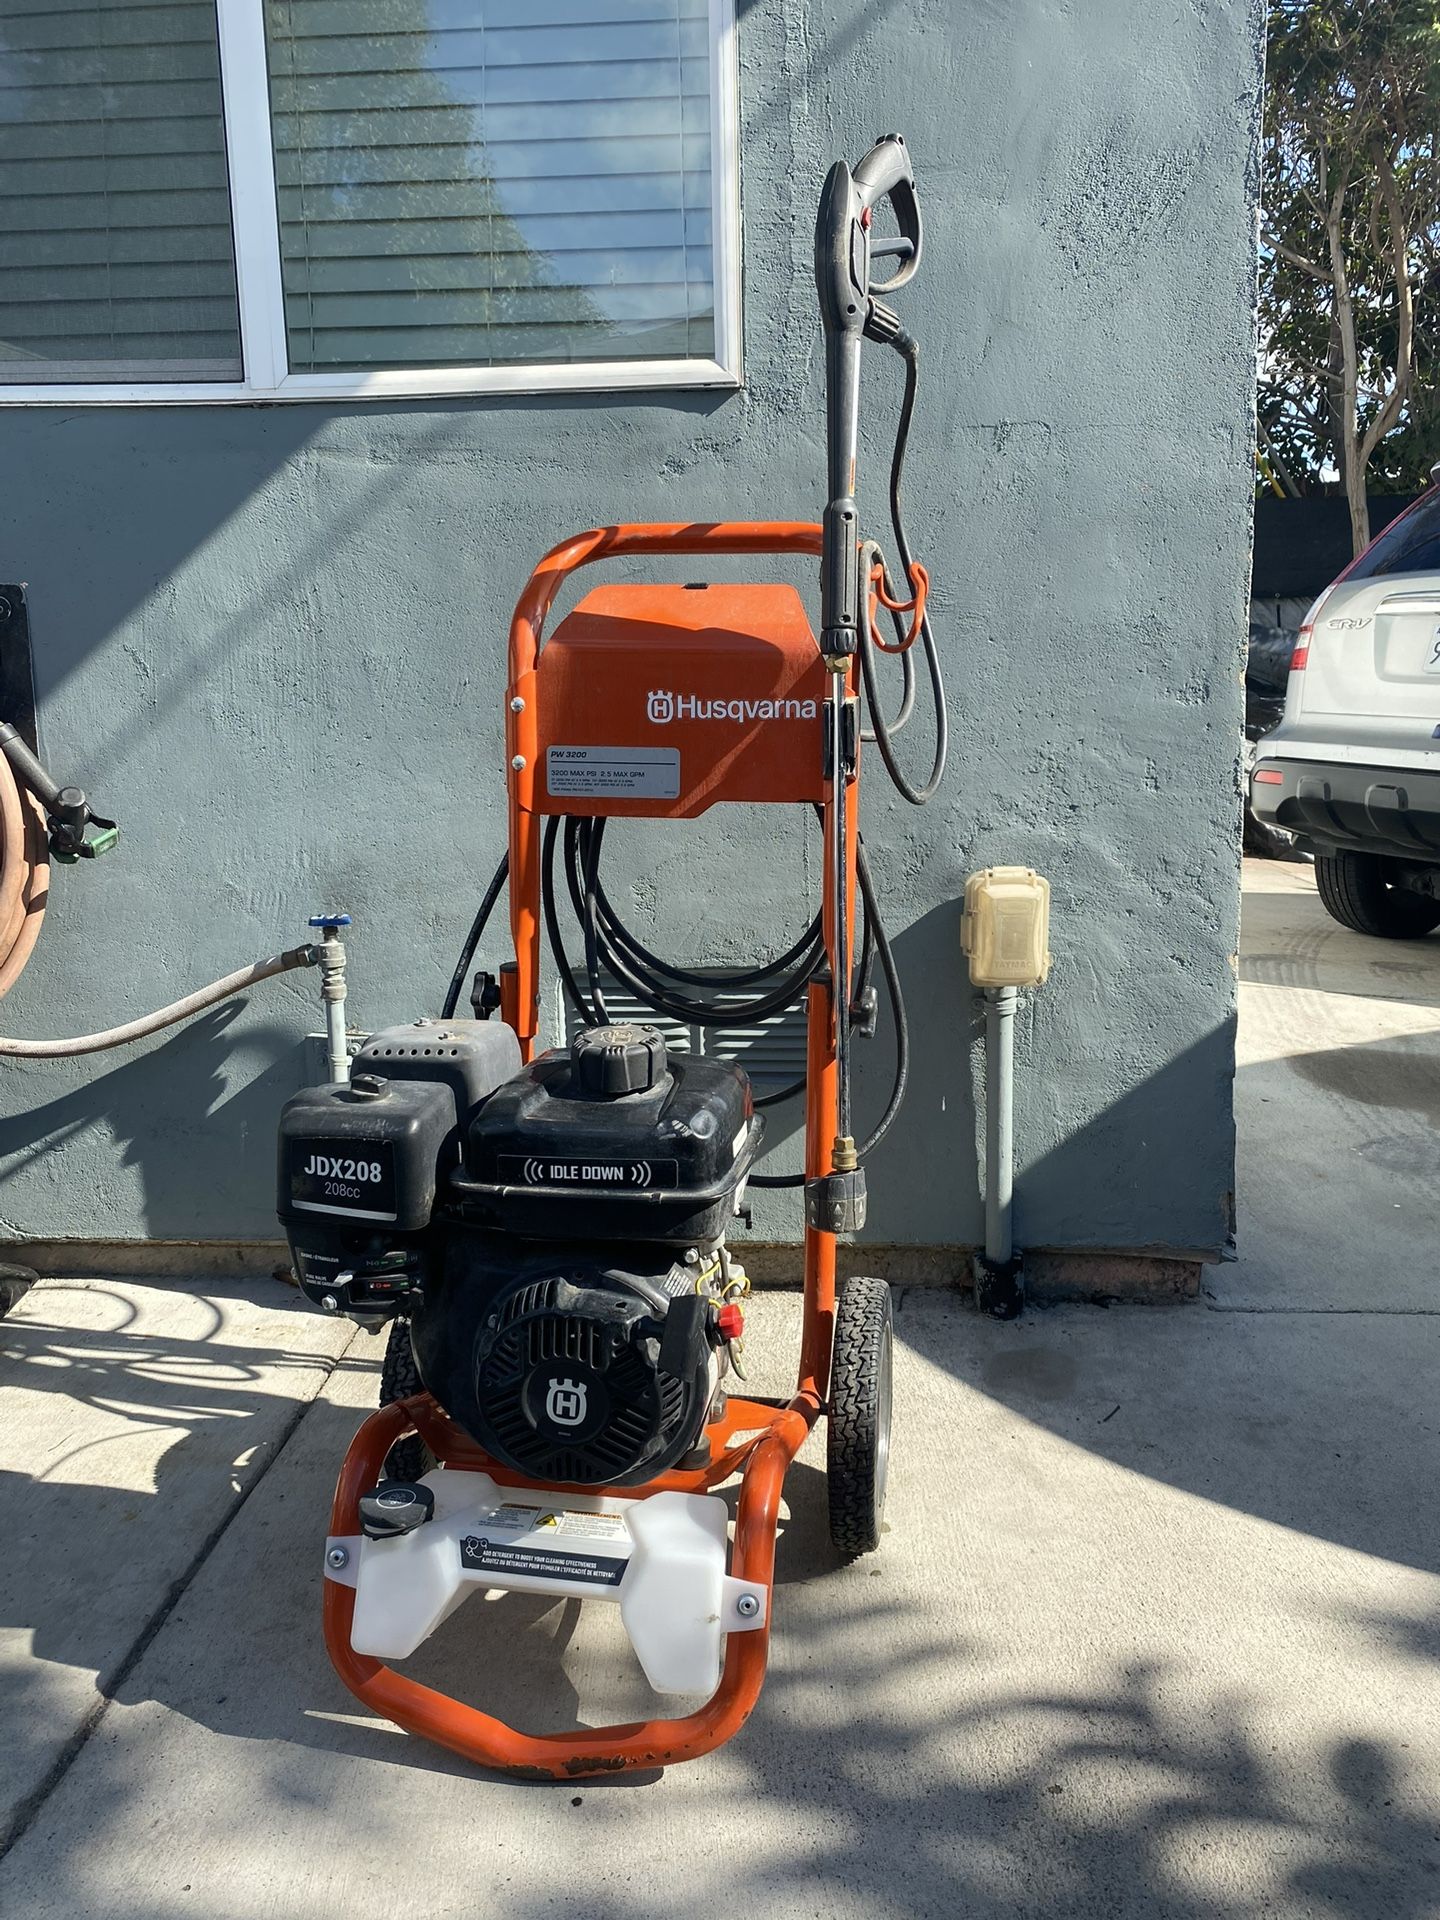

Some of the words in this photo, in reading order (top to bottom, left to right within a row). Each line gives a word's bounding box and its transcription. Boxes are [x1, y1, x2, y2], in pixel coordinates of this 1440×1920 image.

[677, 695, 816, 722] Husqvarna
[303, 1155, 382, 1183] JDX208
[550, 1165, 578, 1179] IDLE
[582, 1166, 624, 1180] DOWN
[324, 1181, 361, 1198] 208cc
